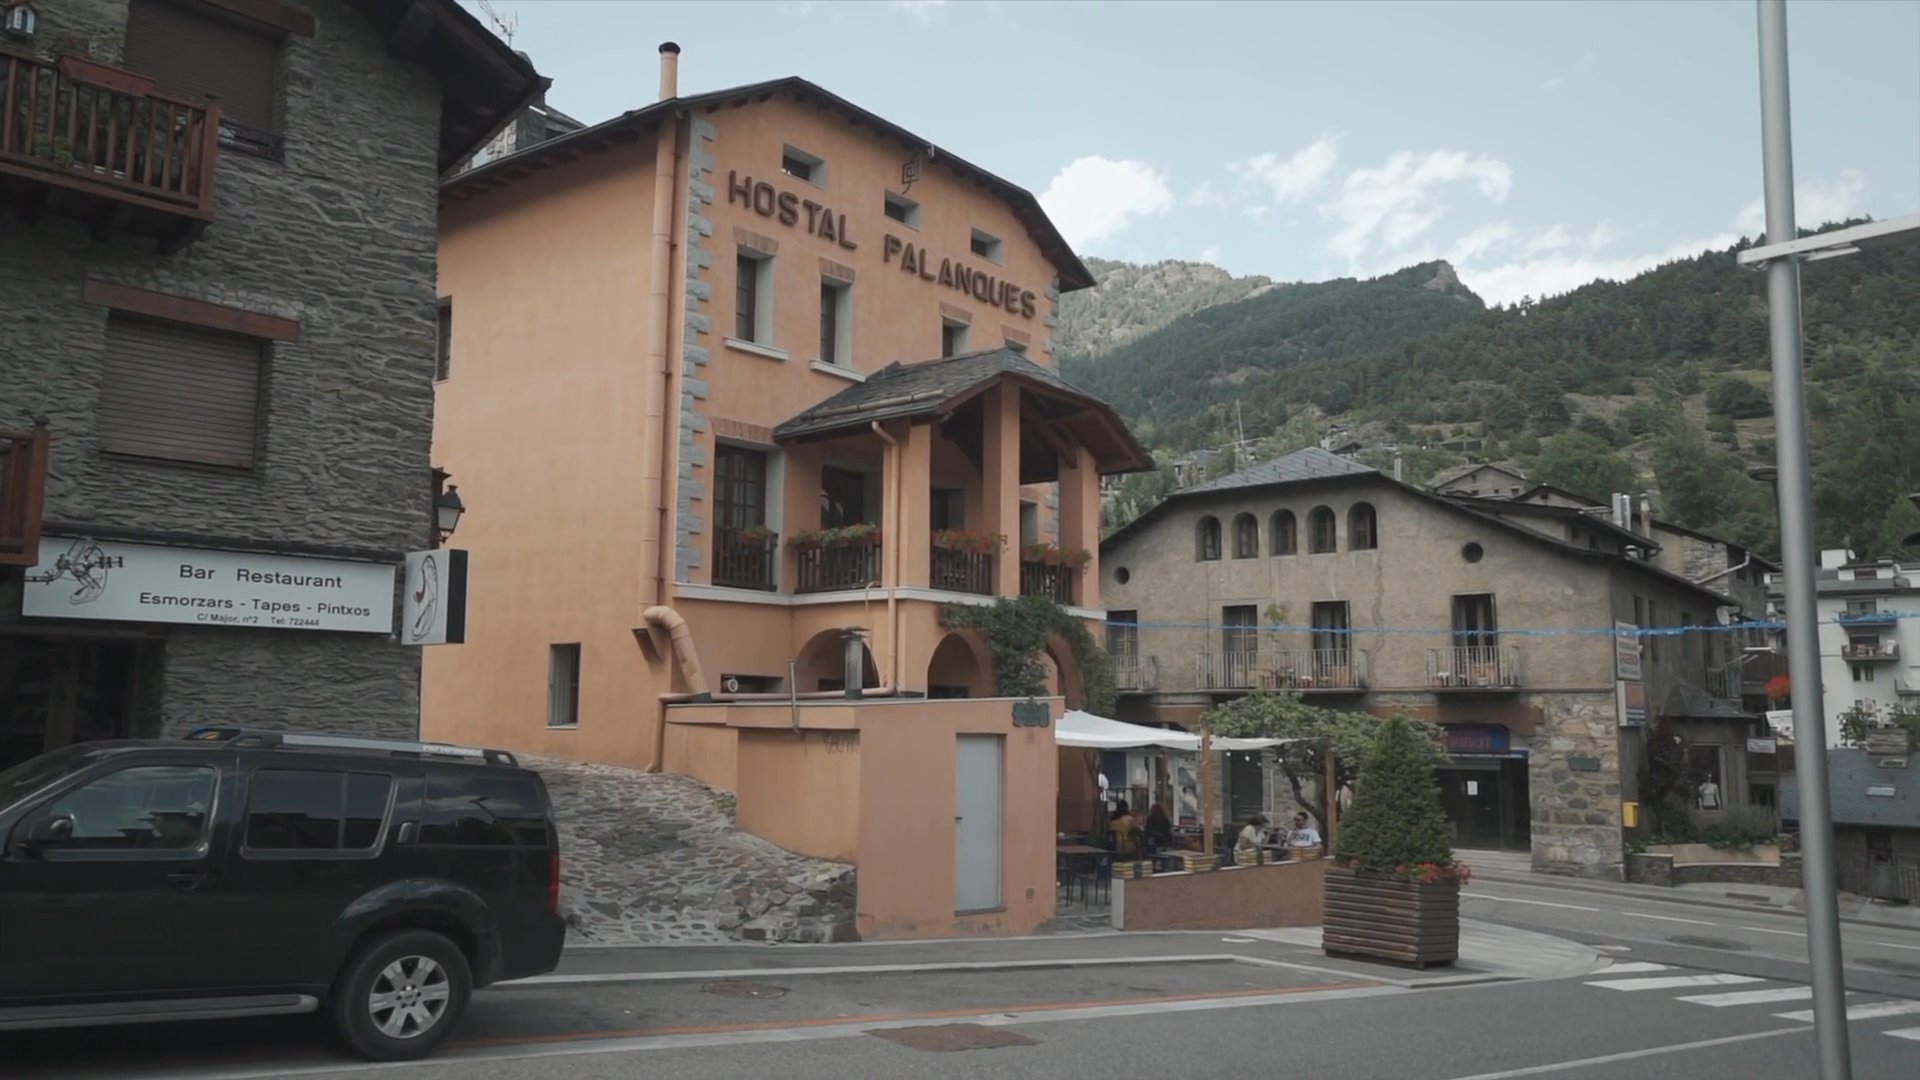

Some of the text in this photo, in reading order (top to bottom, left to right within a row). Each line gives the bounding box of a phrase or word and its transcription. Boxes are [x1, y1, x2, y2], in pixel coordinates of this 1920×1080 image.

[728, 169, 1037, 320] HOSTAL PALANQUES
[179, 564, 343, 588] Bar Restaurant
[139, 592, 234, 608] Esmorzars
[252, 598, 301, 614] Tapes
[317, 602, 371, 617] Pintxos
